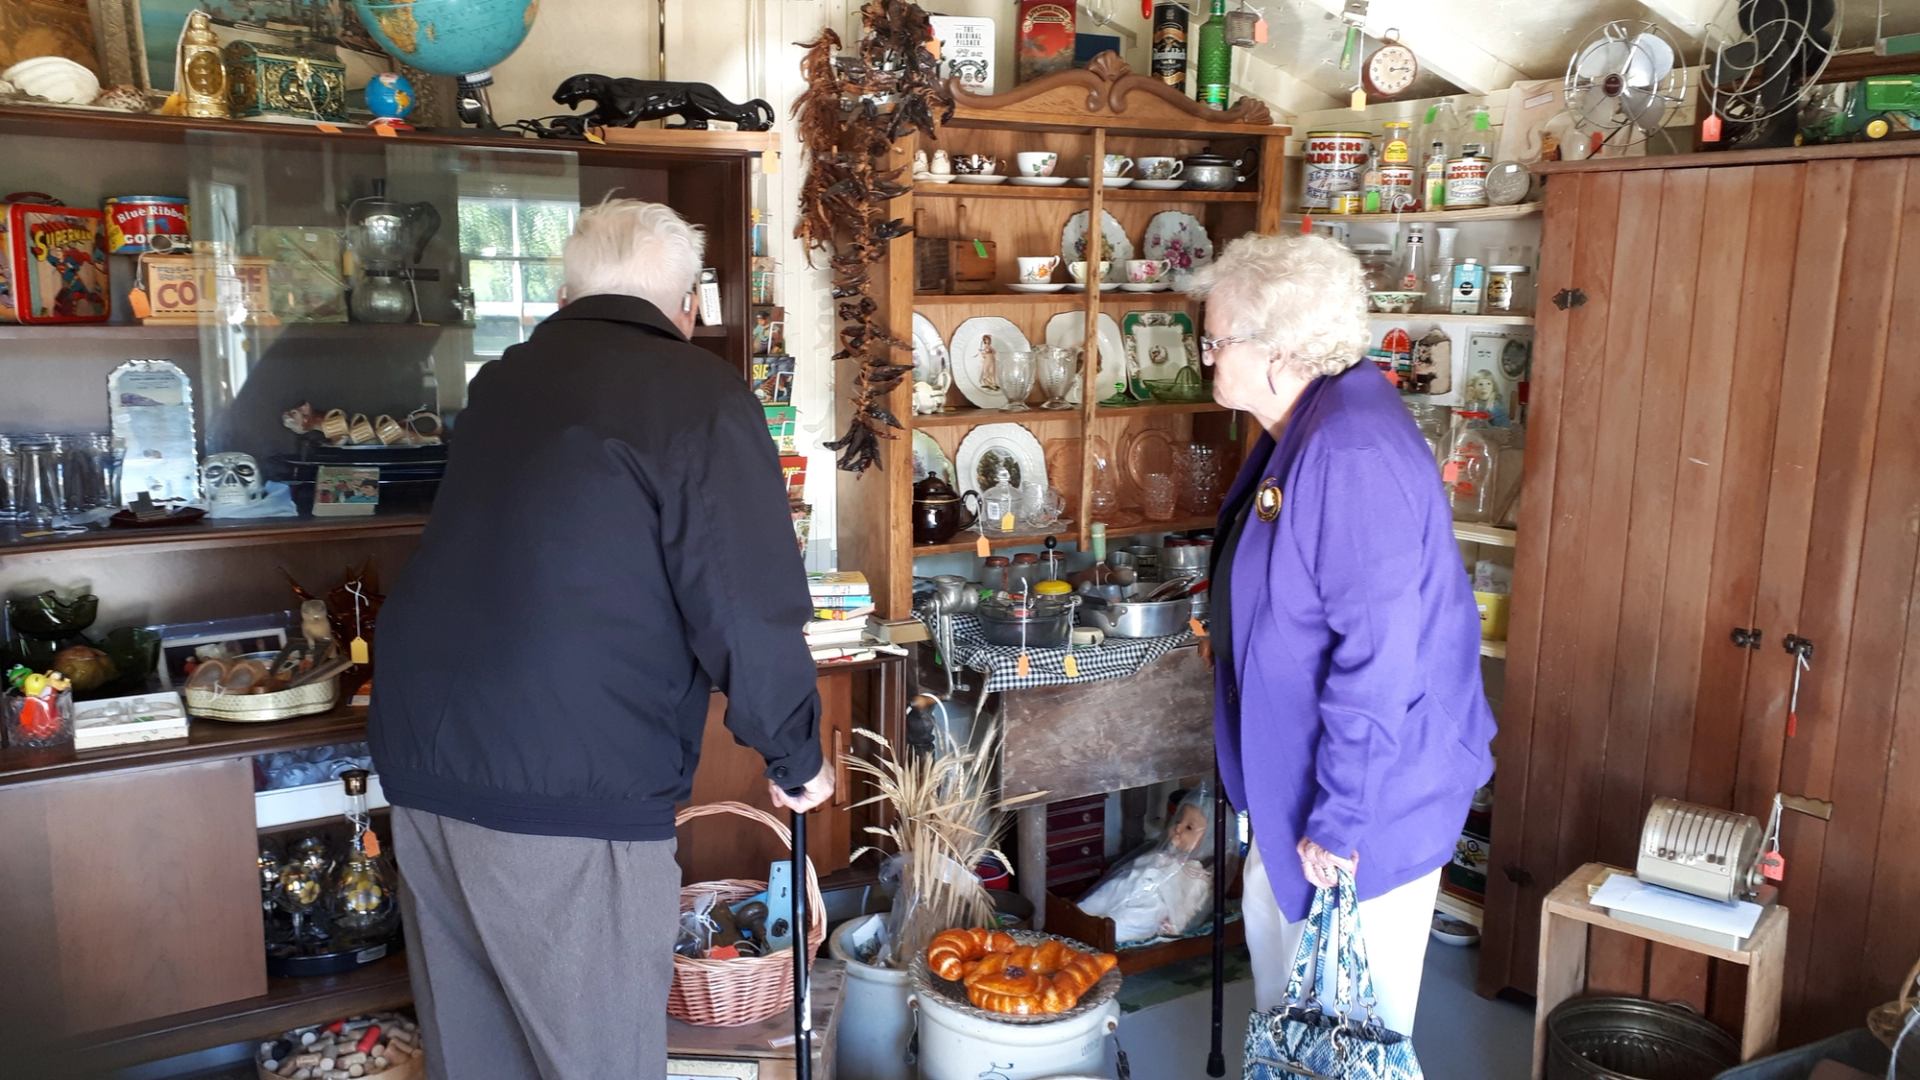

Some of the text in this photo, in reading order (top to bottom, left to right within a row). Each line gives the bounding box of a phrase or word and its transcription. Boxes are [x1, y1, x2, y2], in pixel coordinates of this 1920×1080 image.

[117, 205, 186, 224] Blue Ribbo
[35, 228, 93, 262] SUPERMAN
